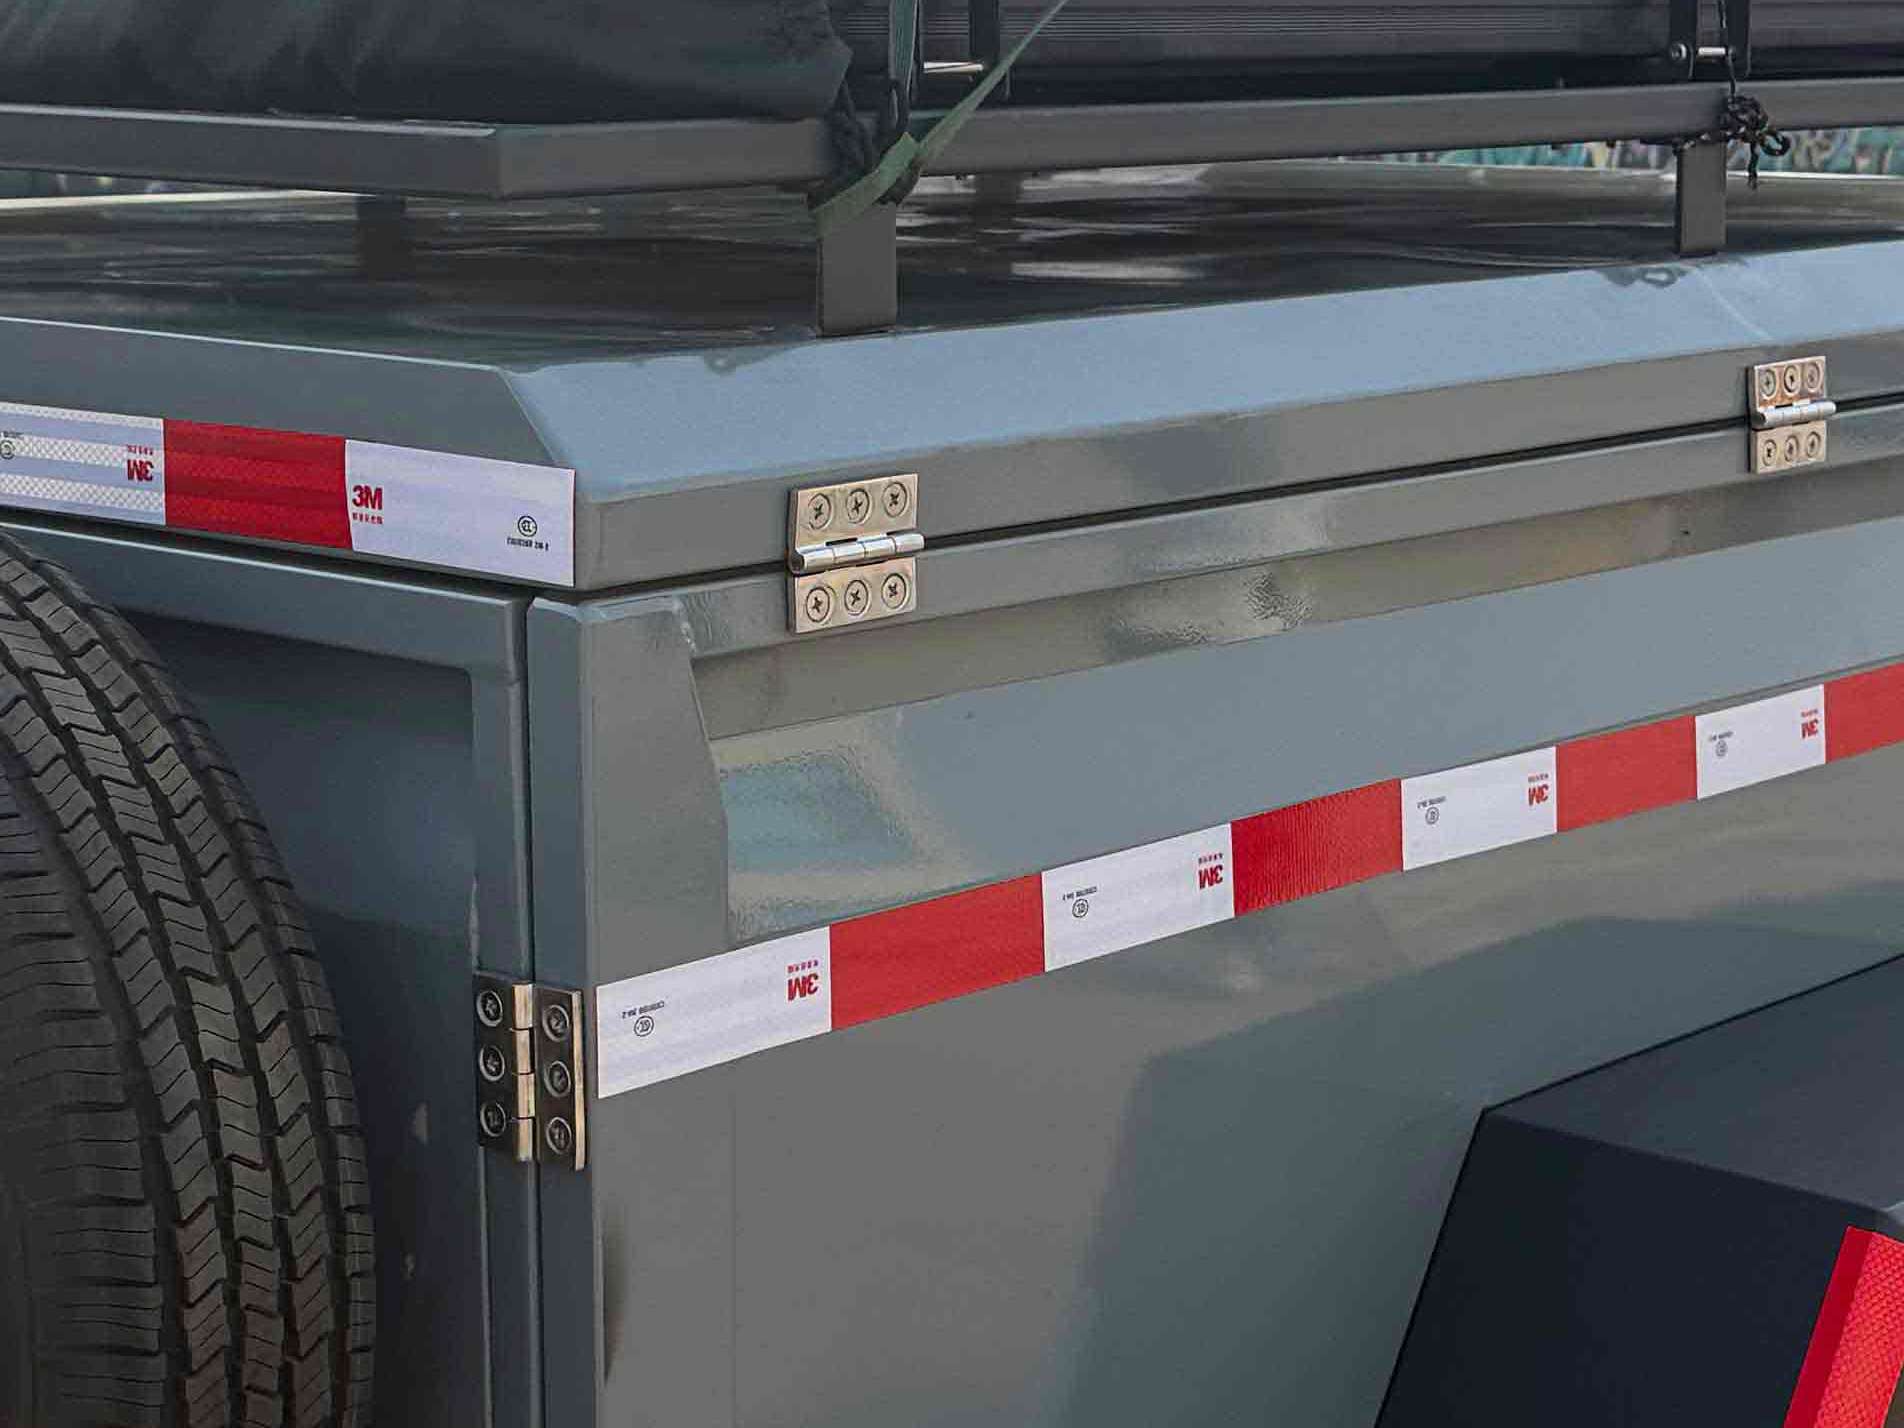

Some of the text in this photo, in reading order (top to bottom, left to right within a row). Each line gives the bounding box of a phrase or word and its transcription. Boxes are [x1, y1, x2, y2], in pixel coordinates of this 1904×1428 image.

[127, 459, 154, 481] 3M
[351, 484, 384, 511] 3M
[1527, 783, 1549, 807] 3M
[1198, 864, 1224, 891] 3M
[786, 973, 819, 1002] 3M
